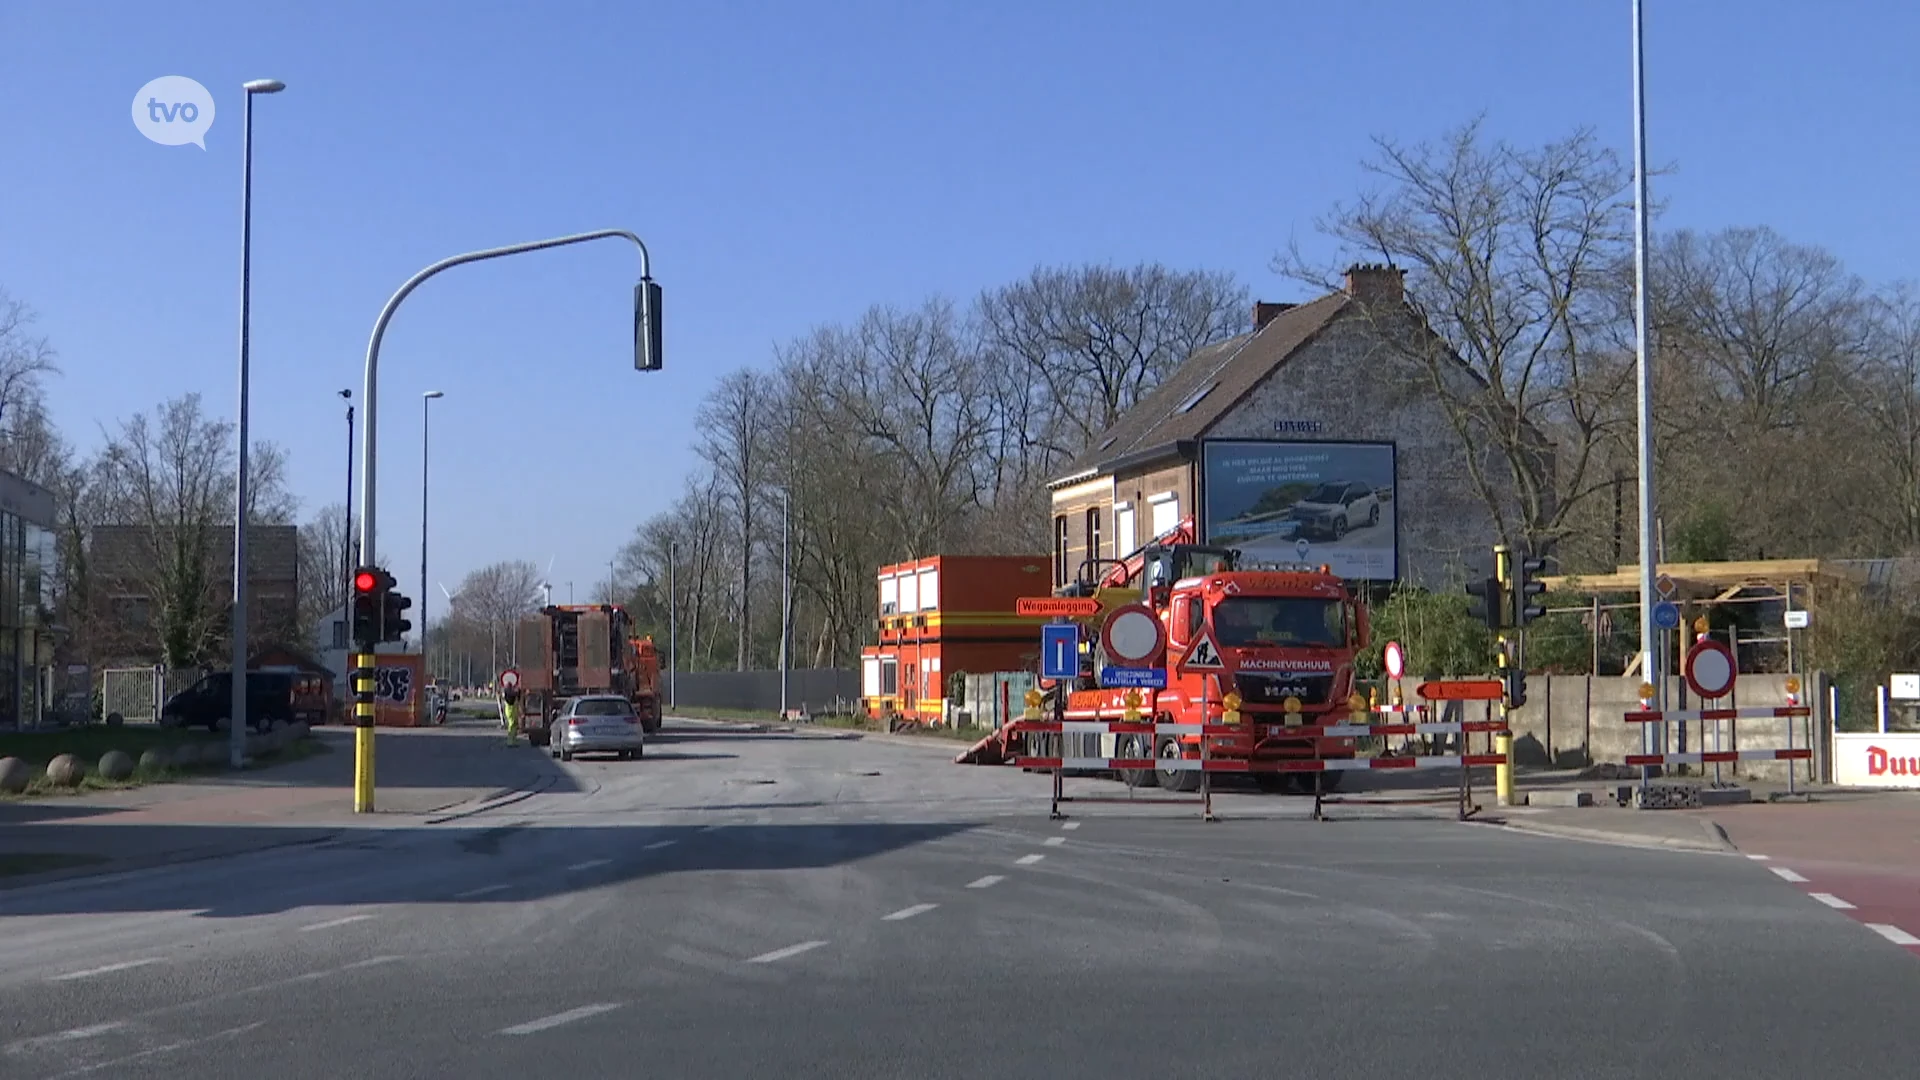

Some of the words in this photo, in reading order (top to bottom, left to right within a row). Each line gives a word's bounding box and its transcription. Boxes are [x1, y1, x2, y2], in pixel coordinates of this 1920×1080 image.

[1022, 600, 1093, 613] Wegomlegging
[1240, 660, 1331, 670] MACHINEVERHUUR
[1264, 686, 1308, 697] MAN
